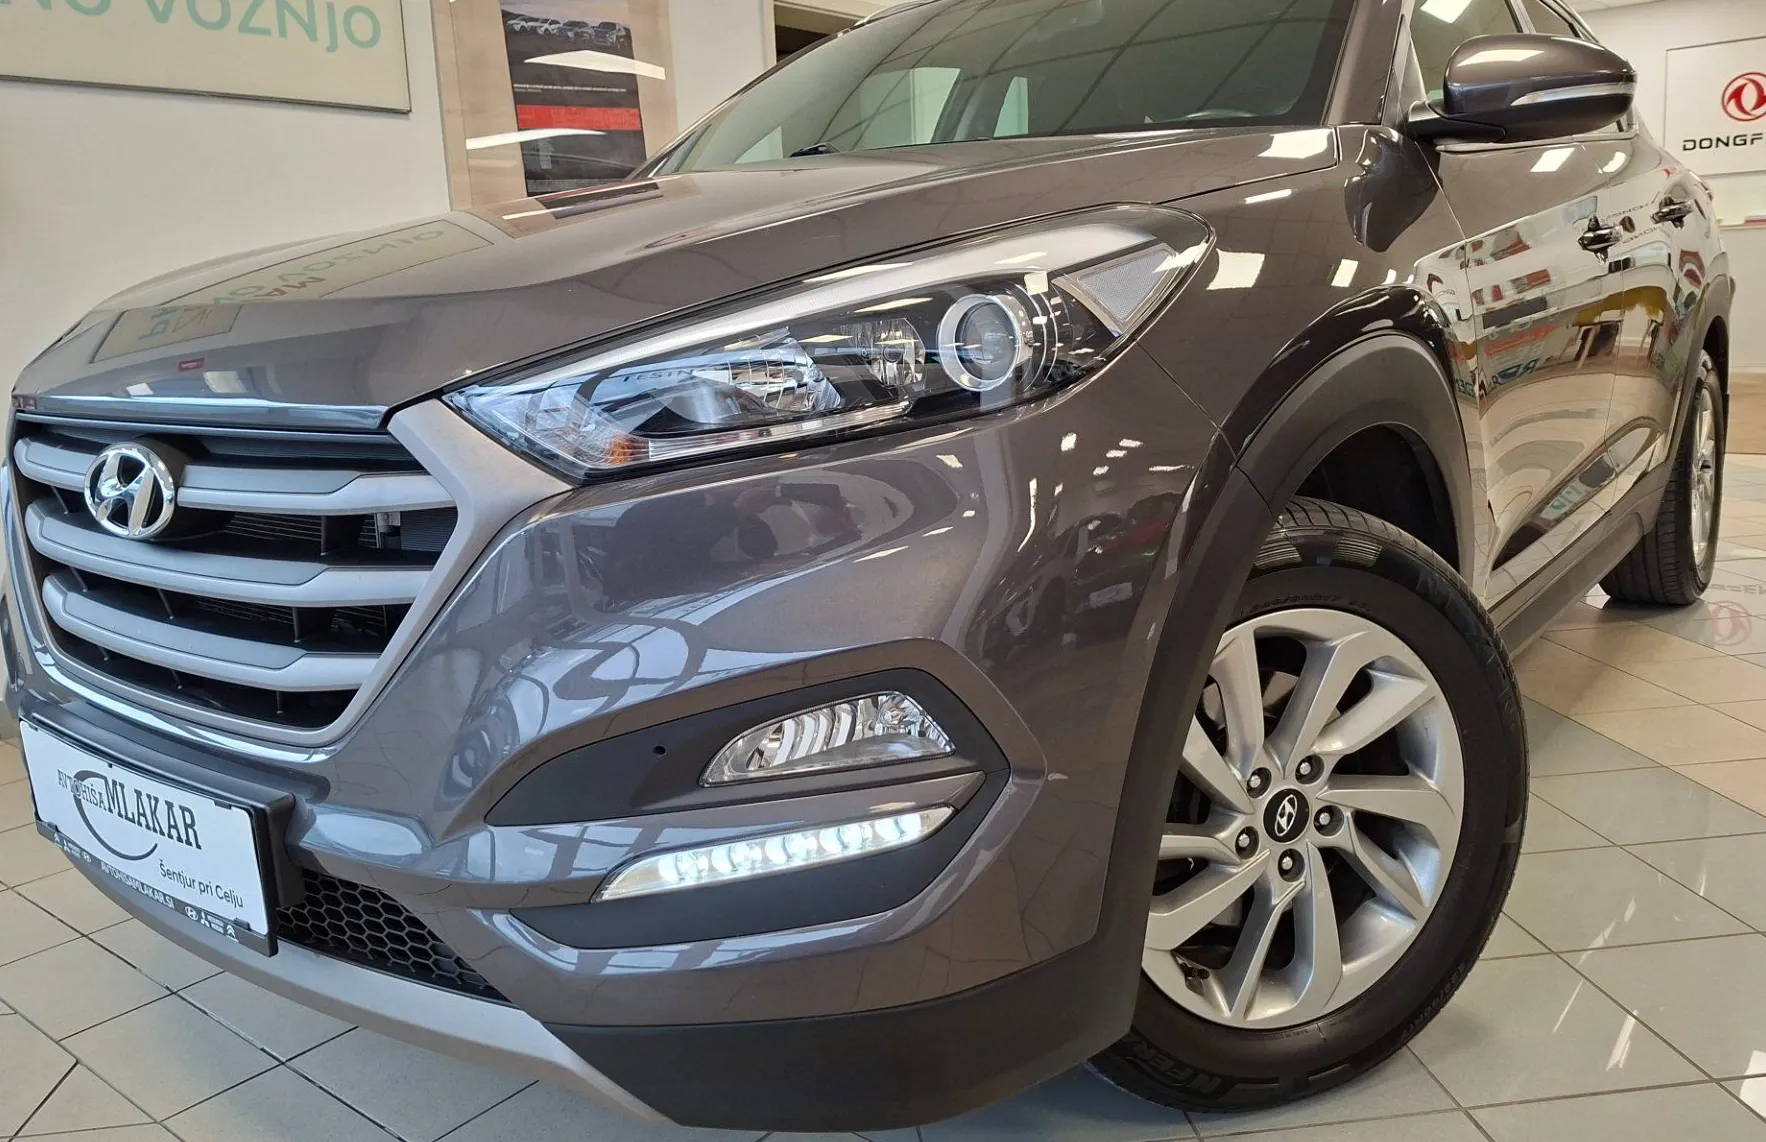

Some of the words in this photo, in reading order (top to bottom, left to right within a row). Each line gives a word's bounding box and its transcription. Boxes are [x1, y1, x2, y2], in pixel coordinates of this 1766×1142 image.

[1683, 133, 1766, 151] DONGF
[103, 775, 202, 849] MLAKAR
[158, 859, 196, 890] Šentjur
[199, 881, 214, 897] pri
[215, 884, 244, 909] Celju
